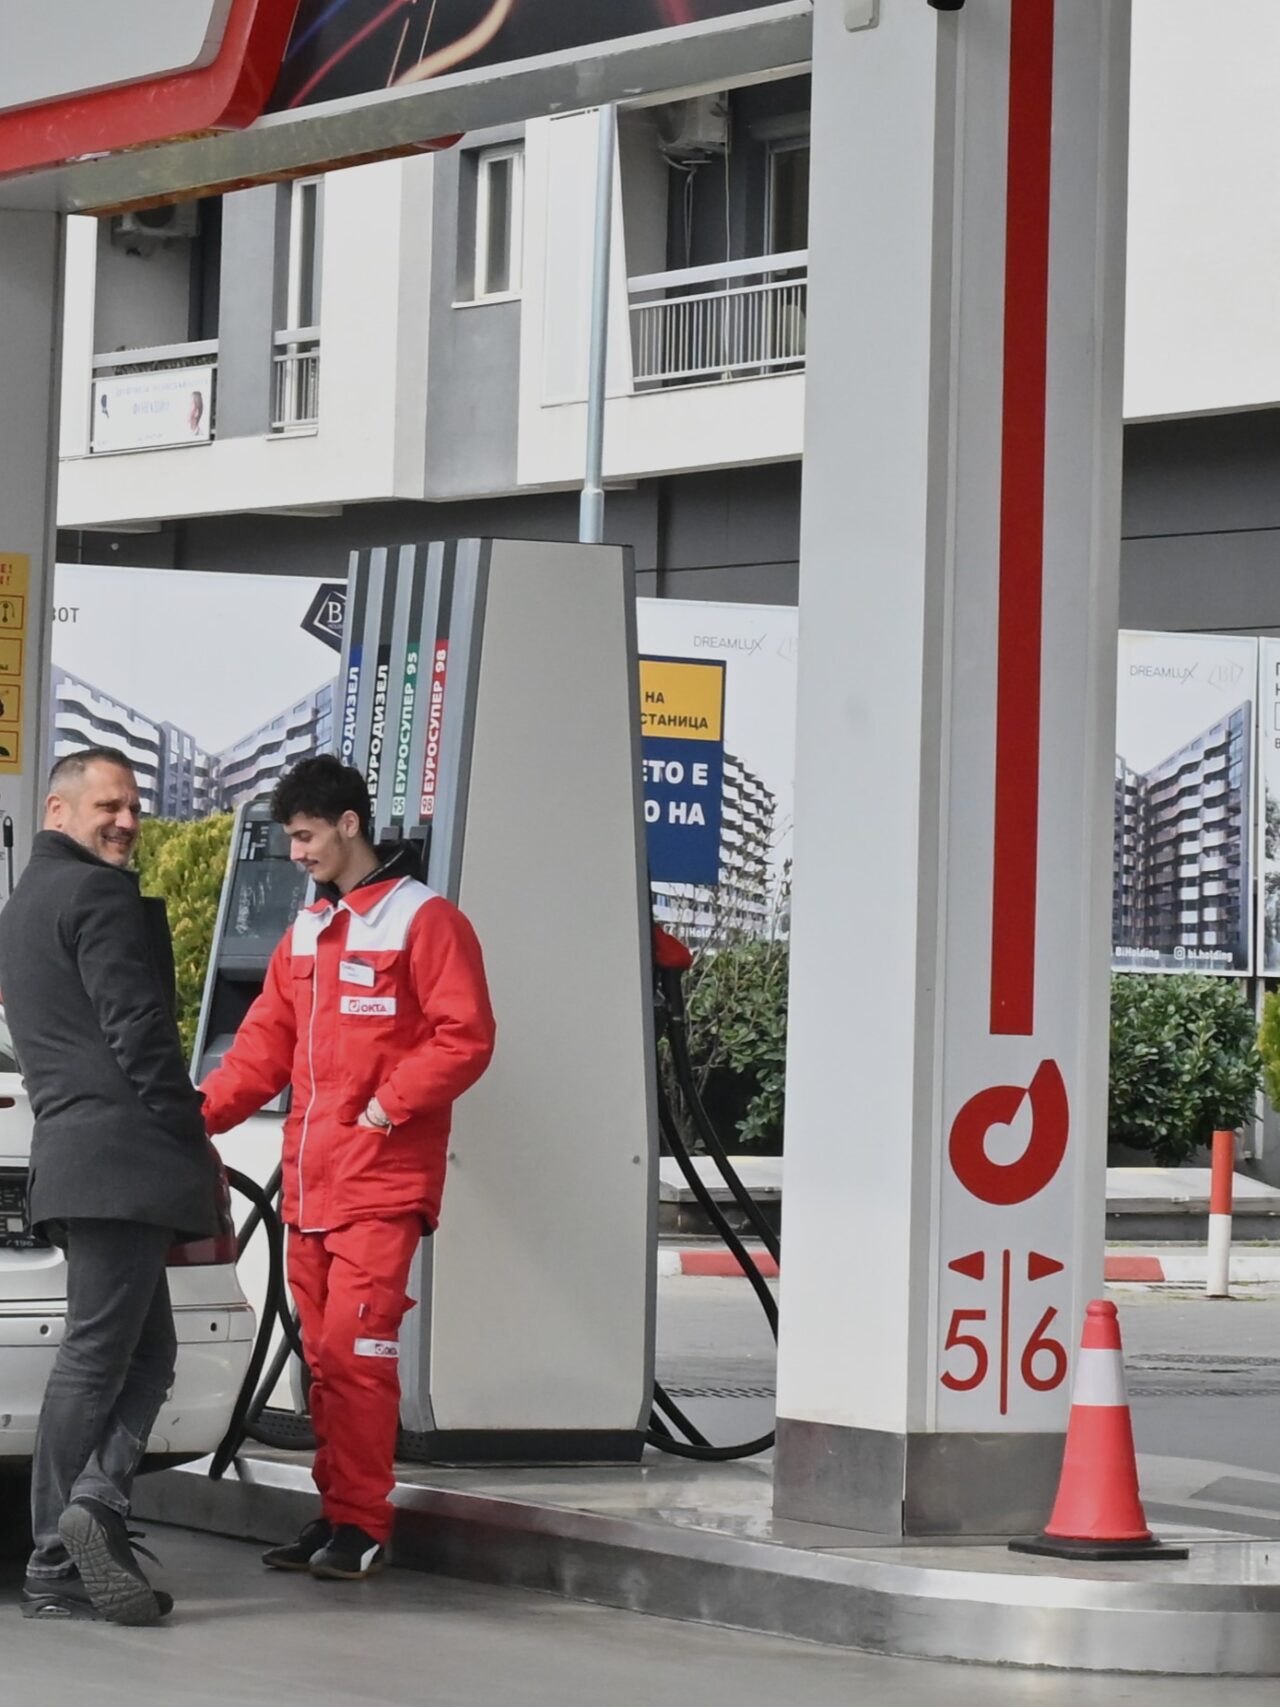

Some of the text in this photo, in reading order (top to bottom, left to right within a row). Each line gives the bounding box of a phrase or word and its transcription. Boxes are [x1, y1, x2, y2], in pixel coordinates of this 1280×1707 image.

[693, 633, 767, 656] DREAMLUX
[406, 651, 418, 675] 95
[435, 649, 447, 673] 98
[1129, 661, 1199, 685] DREAMLUX
[645, 690, 665, 704] НА
[368, 664, 389, 795] ЕУРОДИЗЕЛ
[640, 712, 709, 730] СТАНИЦА
[394, 682, 415, 795] ЕУРОСУПЕР
[423, 680, 444, 793] ЕУРОСУПЕР
[692, 763, 709, 786] Е
[668, 802, 706, 826] НА
[360, 1003, 387, 1013] OKTA
[940, 1305, 1068, 1392] 5 6
